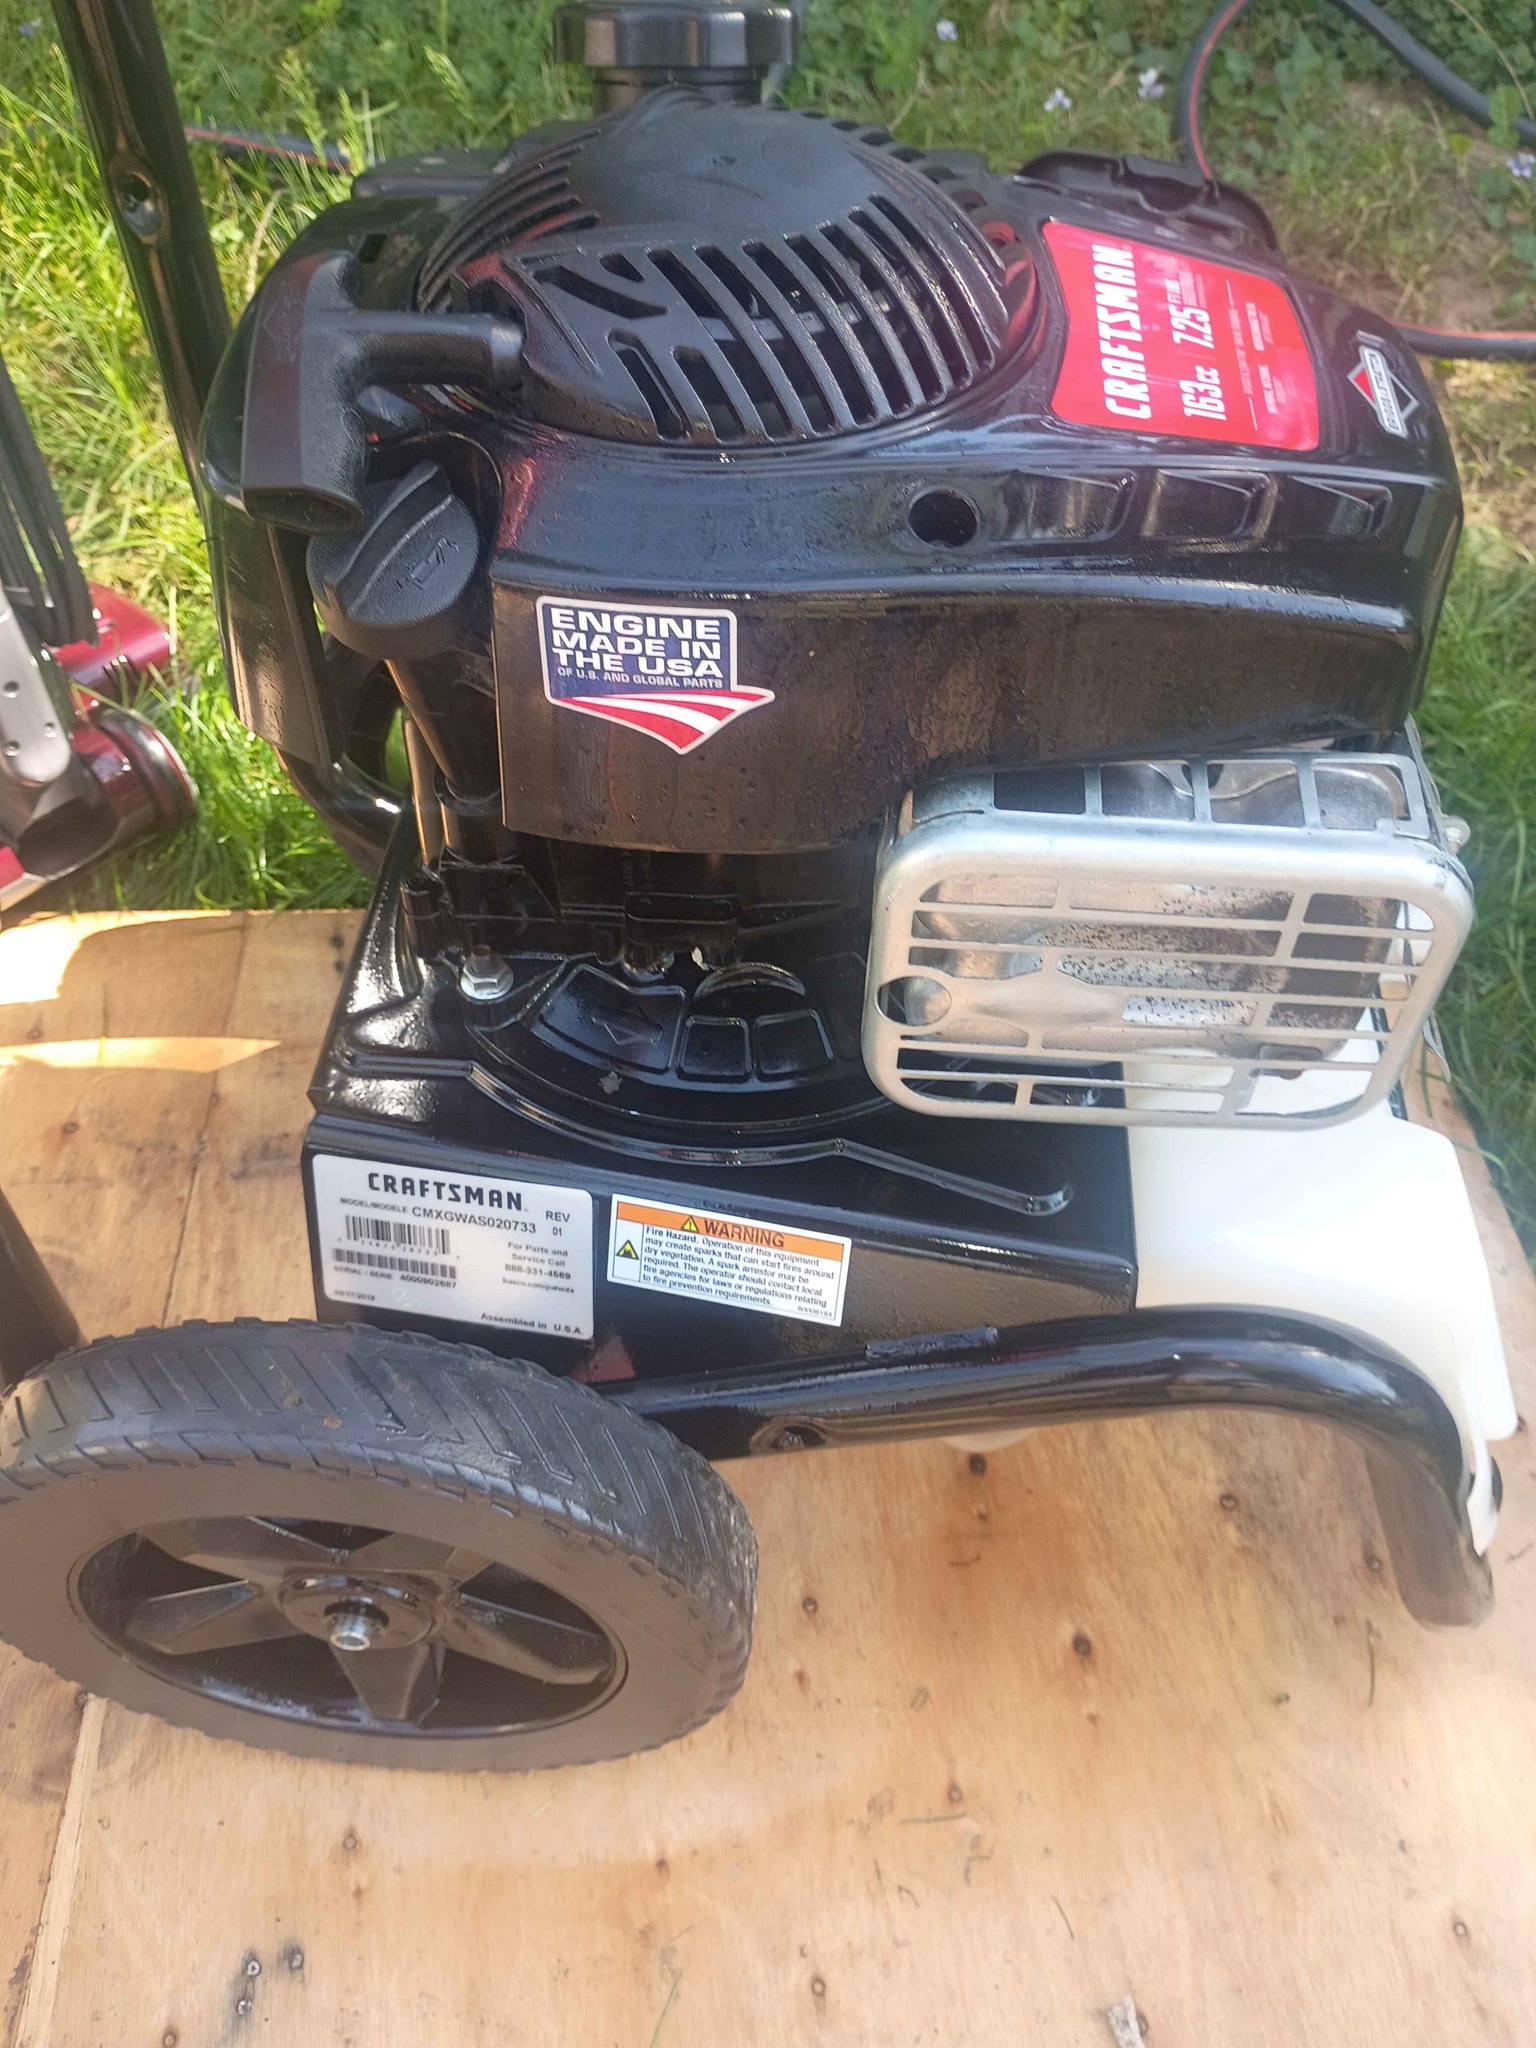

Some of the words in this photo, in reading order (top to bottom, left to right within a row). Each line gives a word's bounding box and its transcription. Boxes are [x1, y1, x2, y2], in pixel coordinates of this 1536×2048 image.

[1092, 244, 1152, 420] CRAFTSMAN
[1168, 304, 1215, 349] 7.25
[1178, 365, 1227, 421] 163cc
[550, 607, 721, 640] ENGINE
[552, 629, 666, 657] MADE
[680, 640, 721, 660] IN
[552, 648, 624, 672] THE
[638, 657, 724, 678] USA
[557, 666, 573, 677] OF
[577, 668, 599, 680] U.S.
[603, 671, 630, 684] AND
[633, 675, 680, 688] GLOBAL
[683, 678, 723, 689] PARTS
[368, 1172, 522, 1211] CRAFTSMAN
[412, 1206, 537, 1234] CMXGWAS020733
[545, 1210, 570, 1223] REV
[552, 1226, 562, 1237] 01
[646, 1226, 663, 1236] Fire
[666, 1230, 699, 1244] Hazard.
[702, 1237, 742, 1252] Operation
[745, 1245, 754, 1255] of
[756, 1247, 772, 1257] this
[774, 1251, 819, 1267] equipment
[704, 1219, 784, 1248] WARNING
[508, 1242, 522, 1250] For
[525, 1244, 548, 1254] Parts
[551, 1248, 568, 1257] and
[512, 1253, 545, 1264] Service
[548, 1258, 565, 1267] Call
[644, 1245, 659, 1256] dry
[661, 1250, 706, 1264] vegetation.
[708, 1257, 715, 1266] A
[716, 1261, 740, 1271] spark
[742, 1266, 776, 1278] arrestor
[778, 1272, 796, 1283] may
[798, 1275, 809, 1284] be
[645, 1237, 663, 1248] may
[665, 1241, 692, 1253] create
[694, 1246, 722, 1258] sparks
[724, 1251, 741, 1260] that
[743, 1256, 759, 1264] can
[761, 1259, 781, 1269] start
[783, 1261, 802, 1273] fires
[804, 1267, 835, 1280] around
[643, 1264, 657, 1273] fire
[659, 1269, 696, 1282] agencies
[699, 1275, 710, 1285] for
[713, 1278, 732, 1288] laws
[745, 1284, 792, 1300] regulations
[794, 1294, 827, 1308] relating
[643, 1274, 651, 1282] to
[653, 1275, 667, 1285] fire
[669, 1280, 713, 1294] prevention
[715, 1288, 771, 1305] requirements.
[644, 1256, 681, 1269] required.
[683, 1263, 698, 1273] The
[700, 1267, 735, 1280] operator
[738, 1273, 766, 1285] should
[768, 1279, 800, 1292] contact
[802, 1285, 822, 1296] local
[481, 1312, 535, 1328] Assembled
[538, 1320, 547, 1329] in
